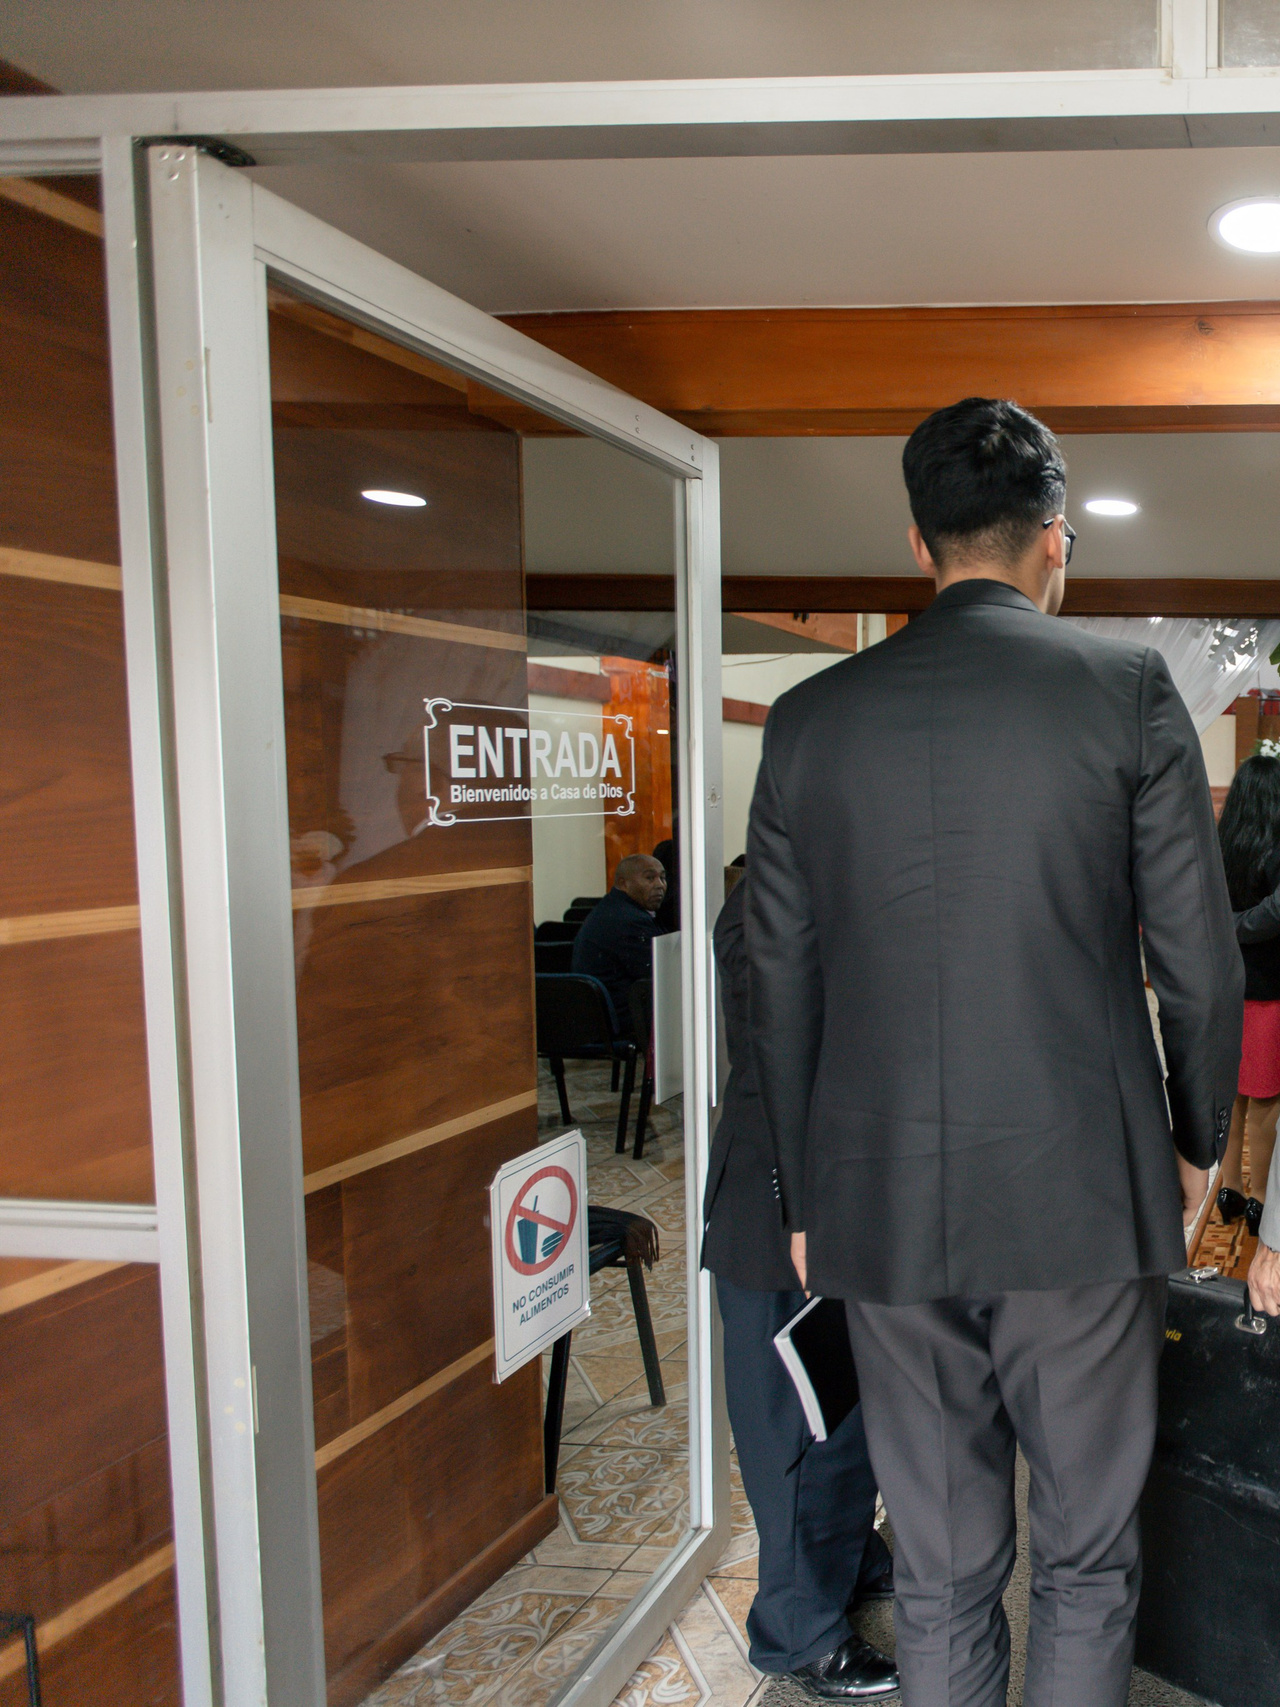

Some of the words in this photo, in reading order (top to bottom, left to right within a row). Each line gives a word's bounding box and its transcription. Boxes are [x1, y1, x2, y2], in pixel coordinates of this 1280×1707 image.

[449, 724, 622, 779] ENTRADA
[450, 783, 538, 803] Bienvenidos
[540, 787, 548, 800] a
[551, 783, 580, 800] Casa
[582, 783, 597, 799] de
[599, 783, 623, 799] Dios
[512, 1295, 526, 1313] NO
[528, 1263, 574, 1302] CONSUMIR
[520, 1283, 569, 1326] ALIMENTOS
